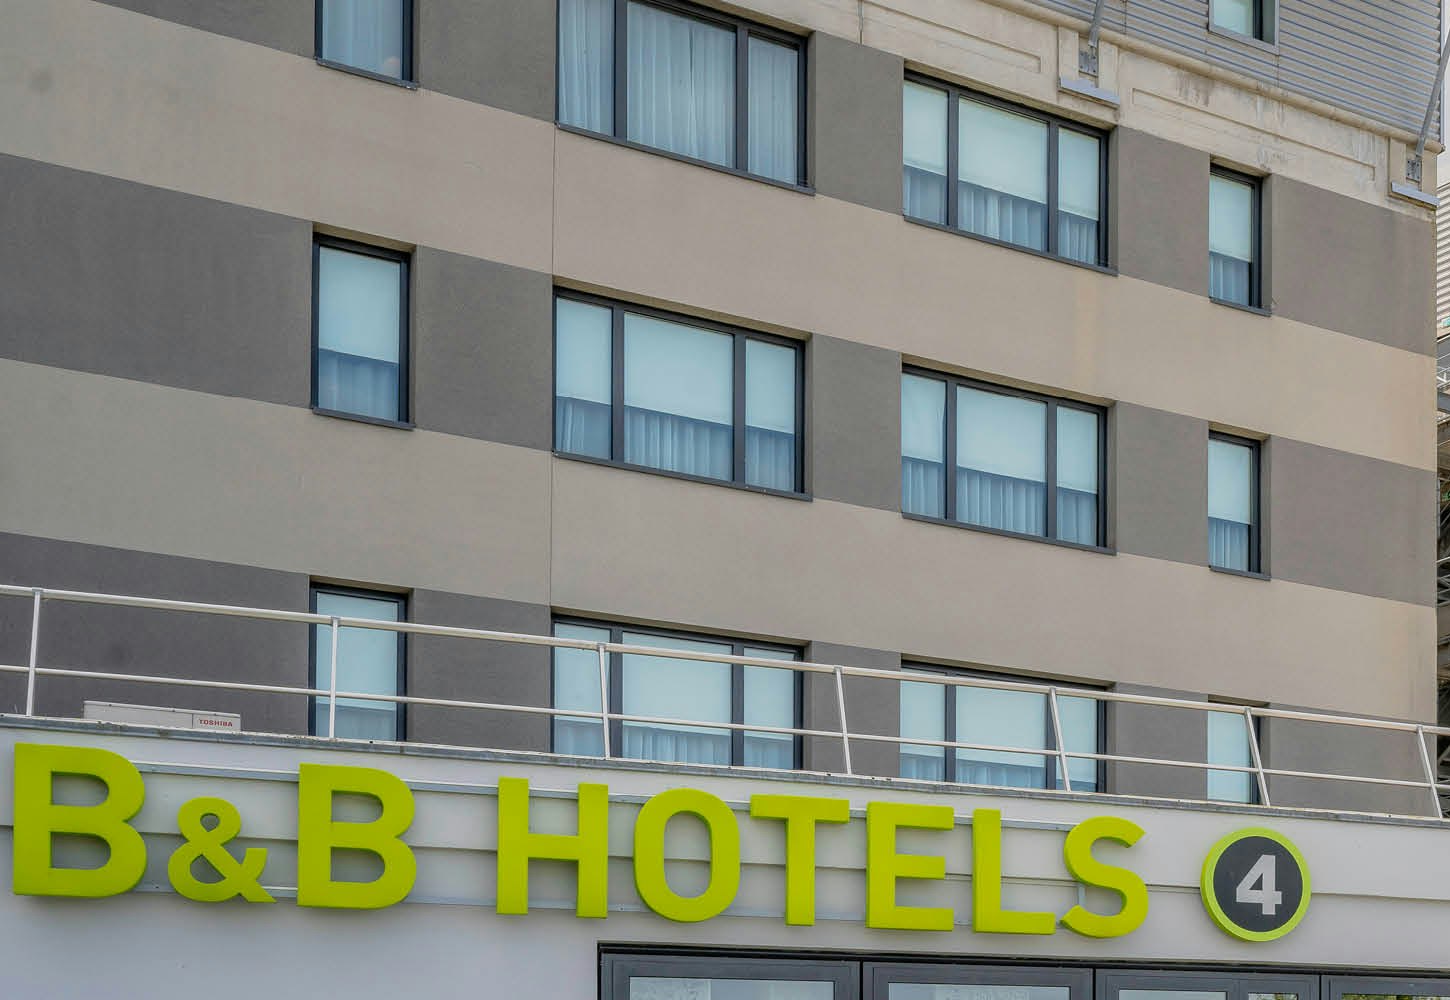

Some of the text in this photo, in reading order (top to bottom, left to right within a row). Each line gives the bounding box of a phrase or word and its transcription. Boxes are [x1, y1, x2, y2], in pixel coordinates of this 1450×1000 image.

[199, 719, 233, 727] TOSHIBA
[13, 742, 1282, 938] B&B HOTELS 4
